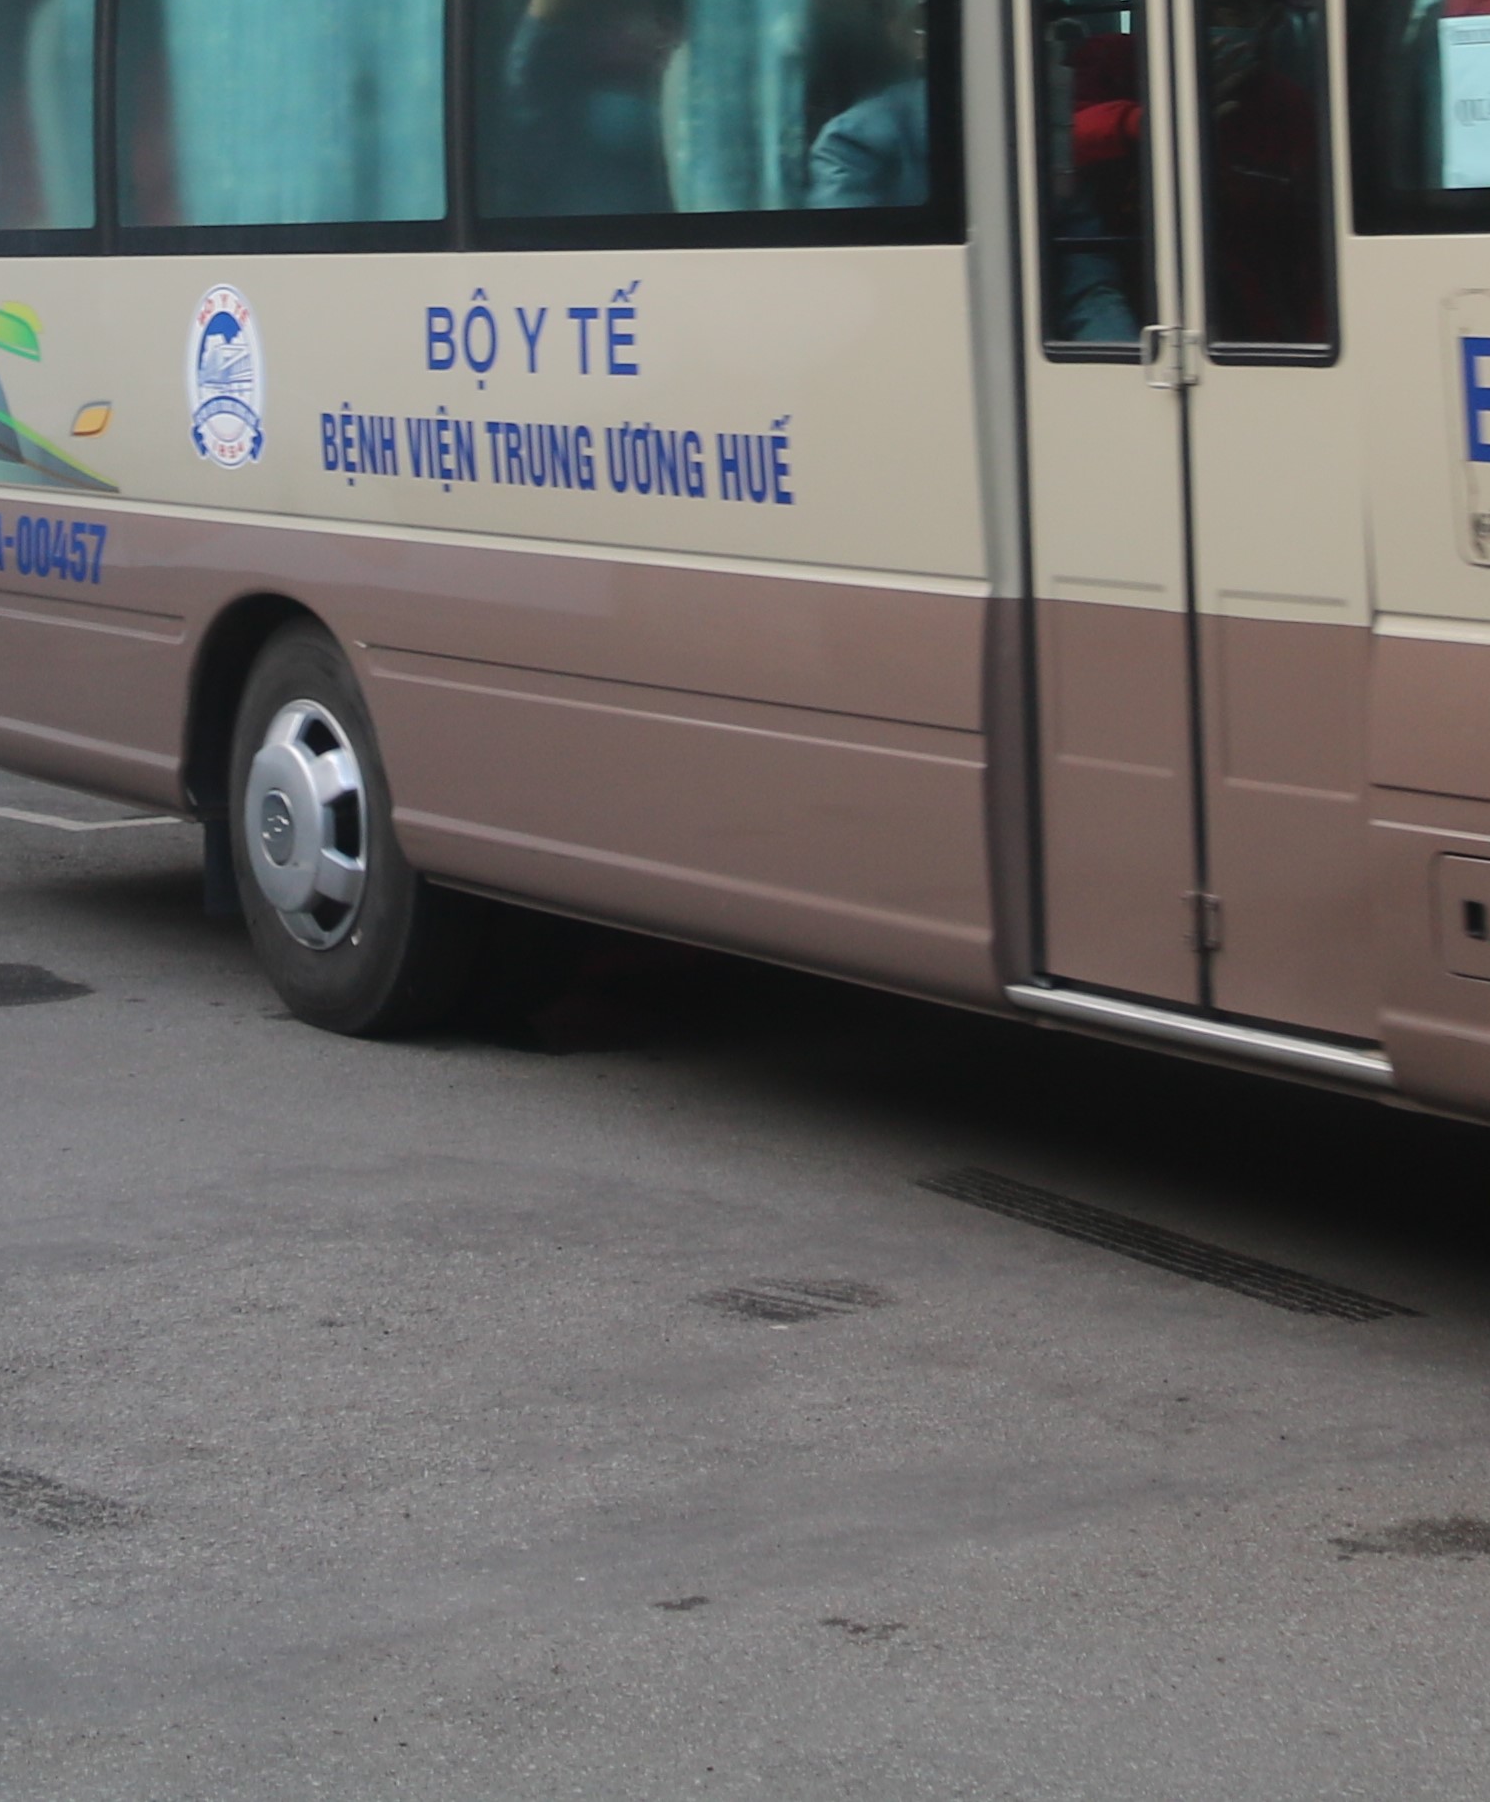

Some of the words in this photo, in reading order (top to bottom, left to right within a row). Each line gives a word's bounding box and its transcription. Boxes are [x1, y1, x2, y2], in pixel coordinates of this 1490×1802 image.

[426, 287, 497, 389] BỘ
[515, 306, 549, 374] Y
[567, 280, 641, 376] TẾ
[320, 401, 399, 486] BỆNH
[405, 405, 477, 492] VIỆN
[484, 420, 597, 491] TRUNG
[605, 420, 706, 499] ƯƠNG
[717, 414, 796, 505] HUẾ
